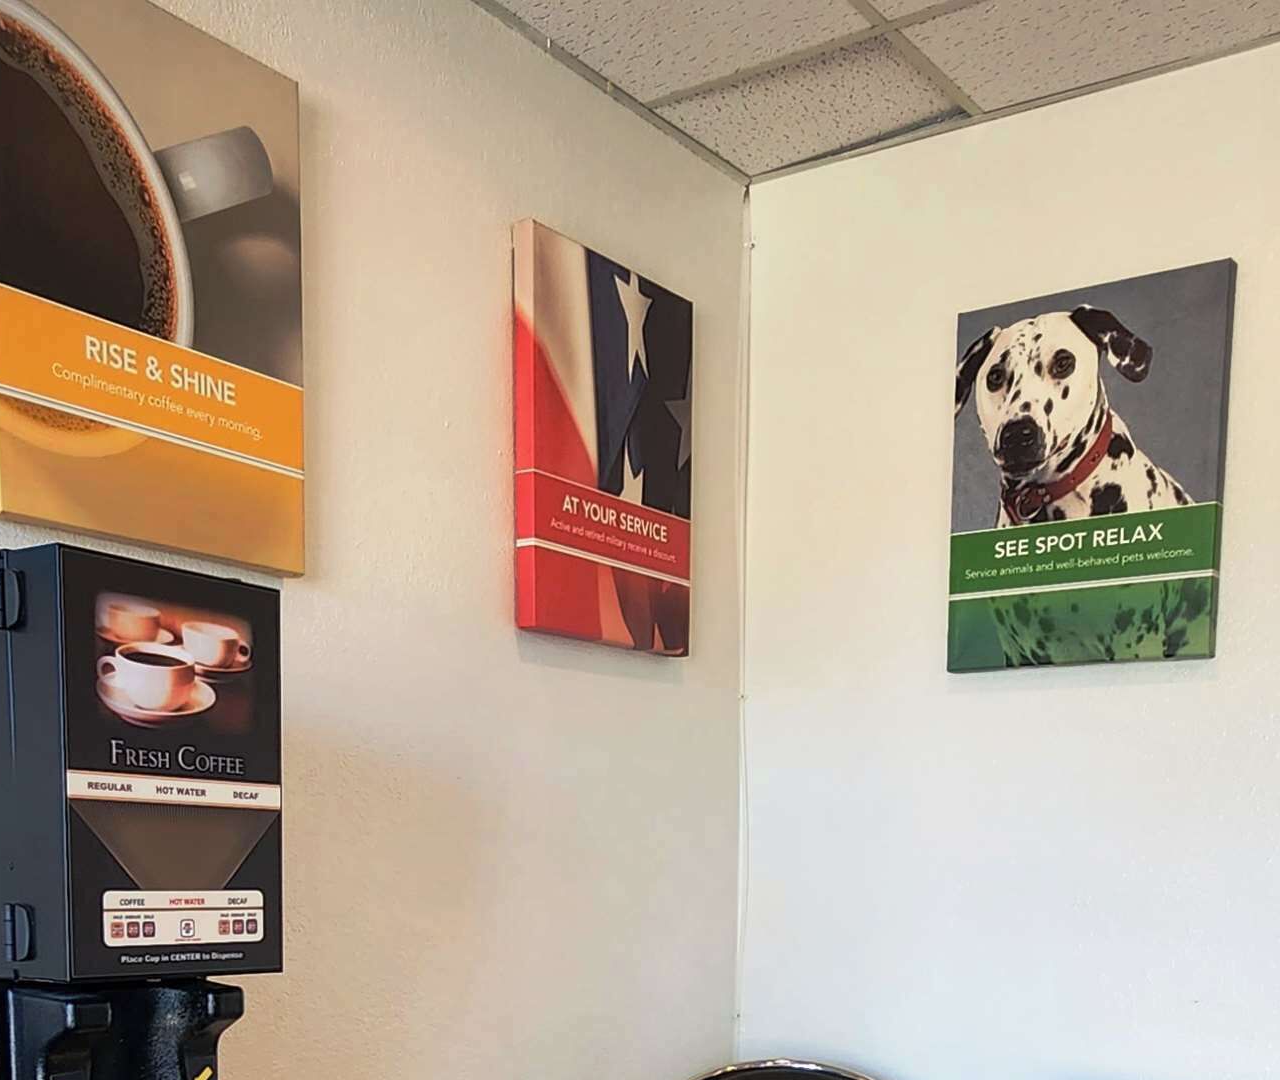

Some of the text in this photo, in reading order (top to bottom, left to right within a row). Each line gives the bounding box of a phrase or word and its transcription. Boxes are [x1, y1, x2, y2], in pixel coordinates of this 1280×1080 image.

[84, 335, 237, 406] RISE & SHINE
[51, 362, 264, 441] Complimentary coffee every morning.
[562, 494, 669, 543] AT YOUR SERVICE
[572, 524, 584, 536] and
[993, 522, 1164, 560] SEE SPOT RELAX
[964, 545, 1195, 580] Service animals and well-behaved pets welcome.
[87, 781, 133, 793] REGULAR
[155, 785, 207, 797] HOT WATER
[232, 791, 260, 801] DECAF
[119, 898, 146, 907] COFFEE
[169, 897, 206, 906] HOT WATER
[227, 897, 248, 906] DECAF
[120, 954, 143, 964] Place
[144, 953, 160, 964] Cup
[161, 952, 170, 962] in
[170, 951, 201, 961] CENTER
[202, 952, 210, 961] to
